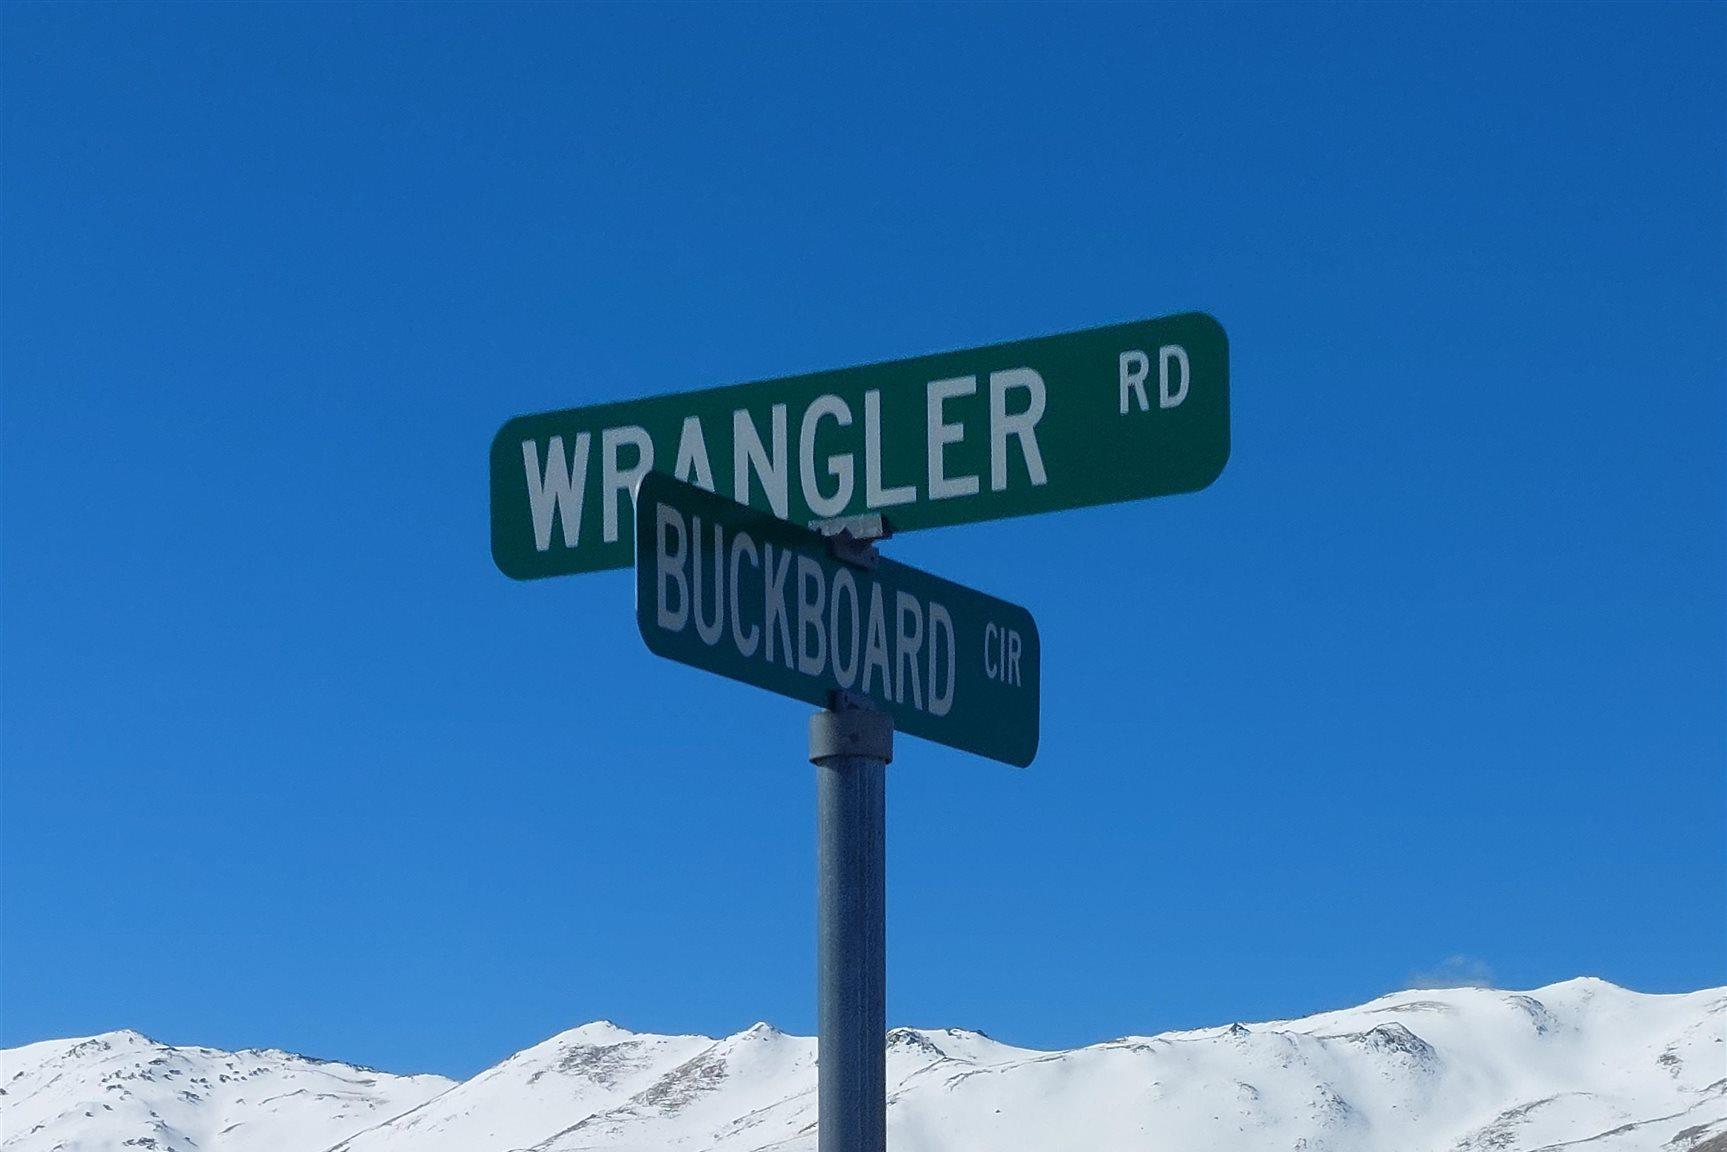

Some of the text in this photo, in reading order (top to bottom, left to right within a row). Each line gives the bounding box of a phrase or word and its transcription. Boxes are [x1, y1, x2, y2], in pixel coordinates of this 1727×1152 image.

[522, 344, 1191, 552] WRANGLER RD
[656, 503, 1023, 717] BUCKBOARD CIR
